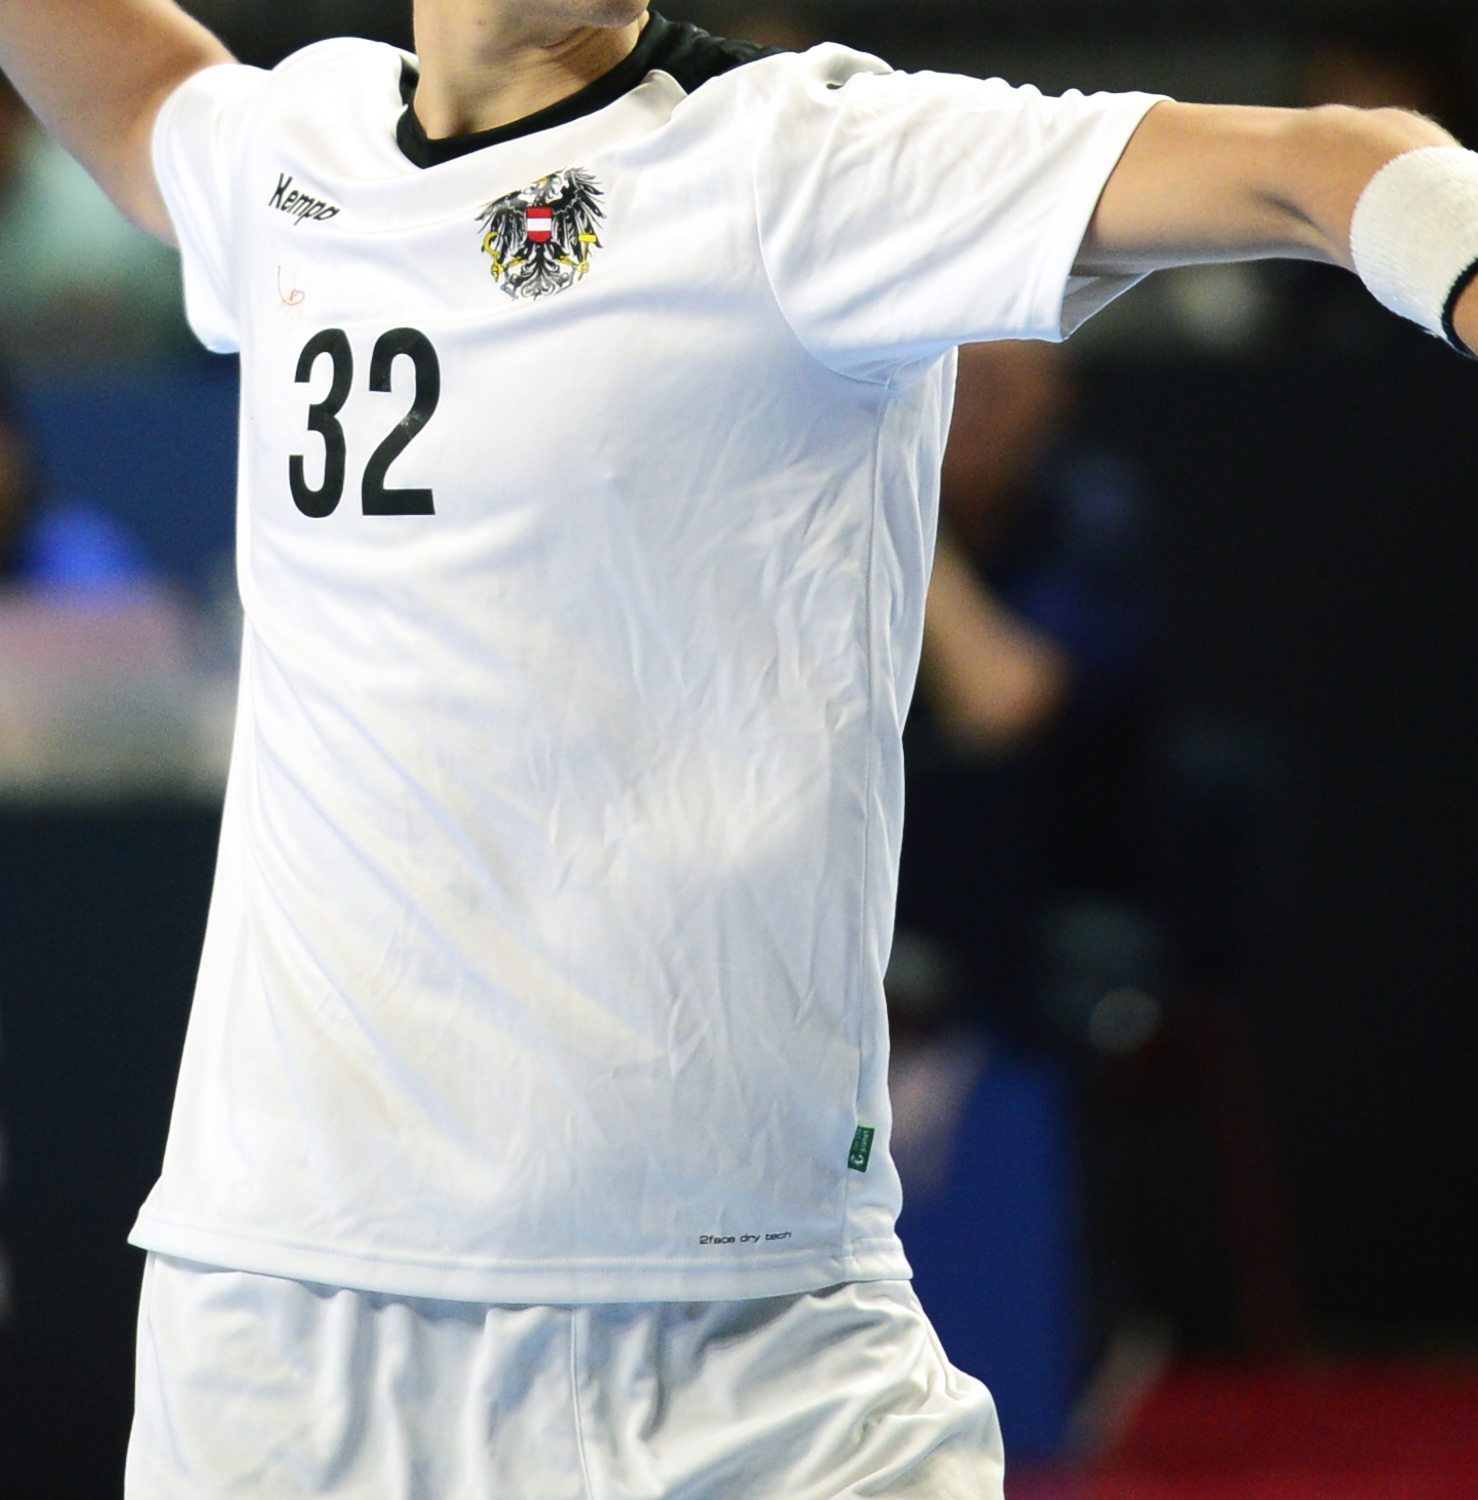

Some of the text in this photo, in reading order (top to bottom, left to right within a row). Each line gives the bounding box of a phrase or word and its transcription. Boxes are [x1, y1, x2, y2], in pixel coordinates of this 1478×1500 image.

[268, 172, 341, 226] Kempa
[288, 327, 441, 518] 32
[739, 1233, 761, 1243] dry
[765, 1230, 792, 1241] tech
